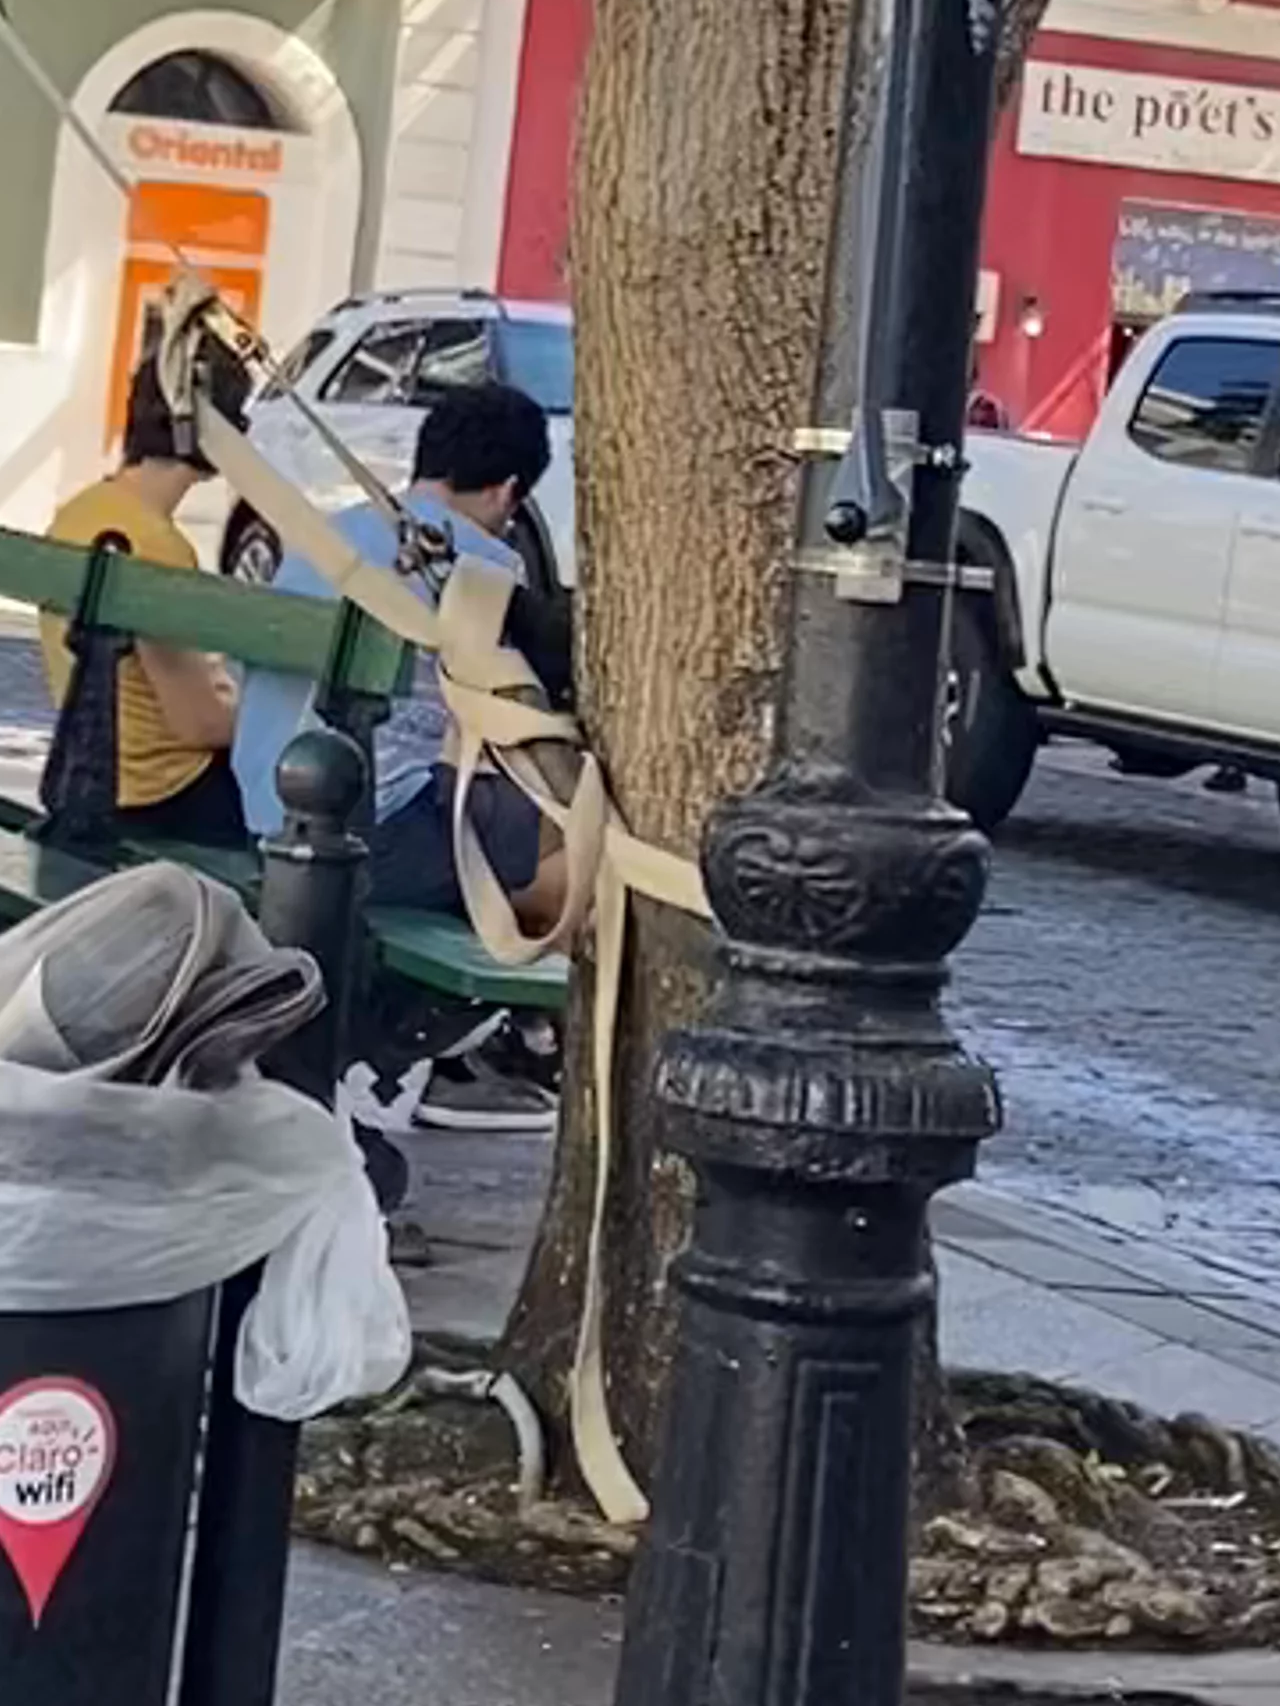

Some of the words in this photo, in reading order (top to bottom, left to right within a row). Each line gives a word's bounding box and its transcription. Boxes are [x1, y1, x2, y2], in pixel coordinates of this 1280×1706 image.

[1041, 73, 1113, 123] the
[127, 125, 283, 172] Oriental
[15, 1470, 75, 1505] wifi
